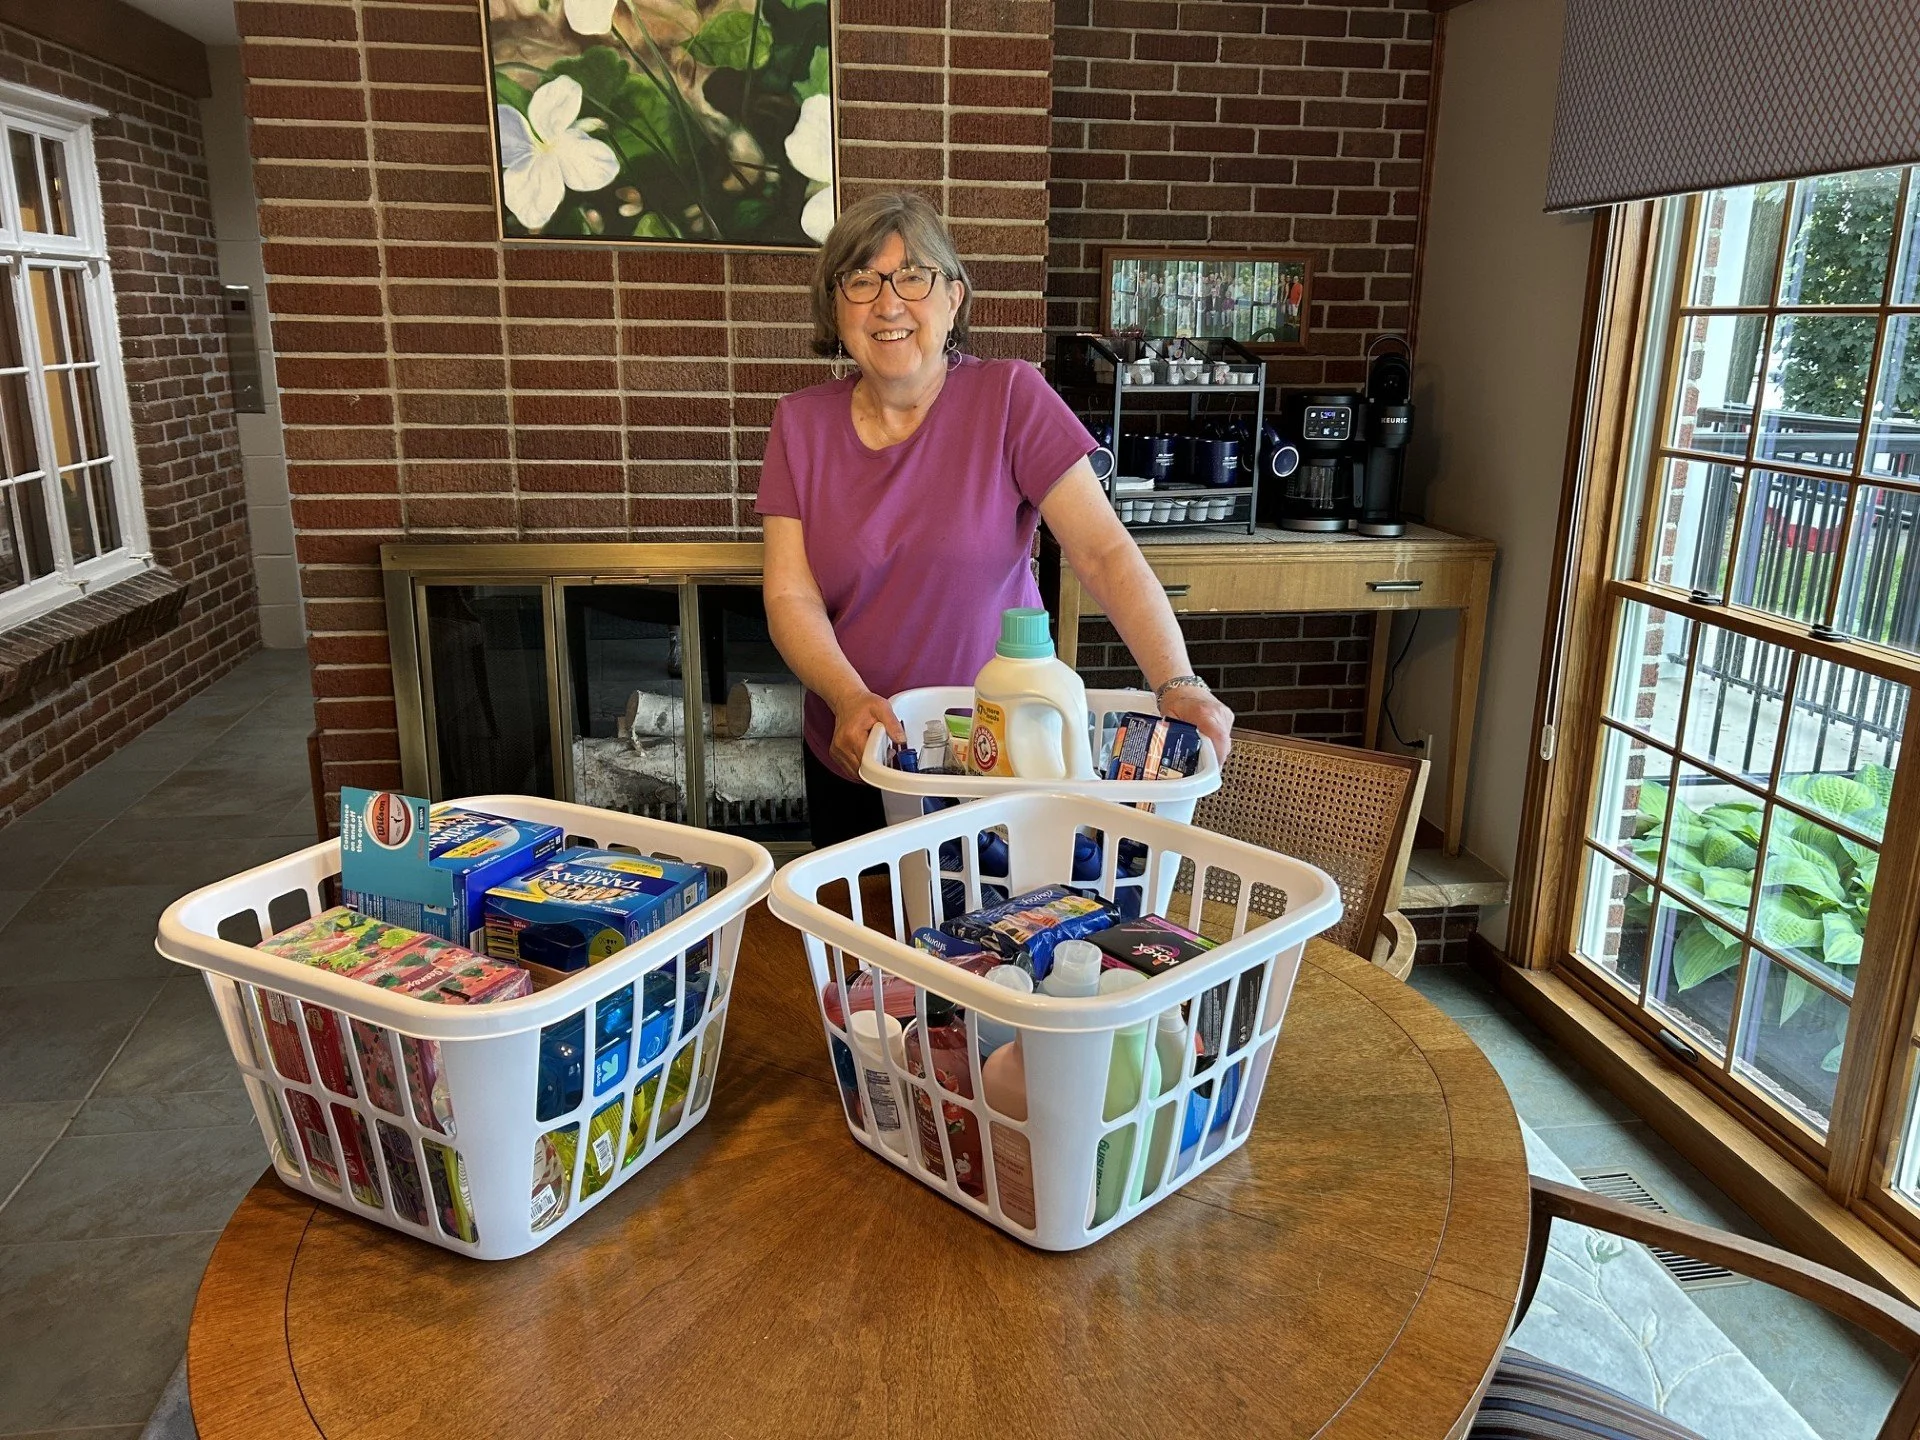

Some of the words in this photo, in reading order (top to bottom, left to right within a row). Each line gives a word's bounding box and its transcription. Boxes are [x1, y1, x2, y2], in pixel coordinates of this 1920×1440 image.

[987, 707, 1000, 715] more
[376, 800, 386, 836] Wilson
[429, 819, 486, 851] AMPAX
[350, 841, 356, 852] on
[550, 870, 642, 890] TAMPAX
[923, 933, 947, 952] always
